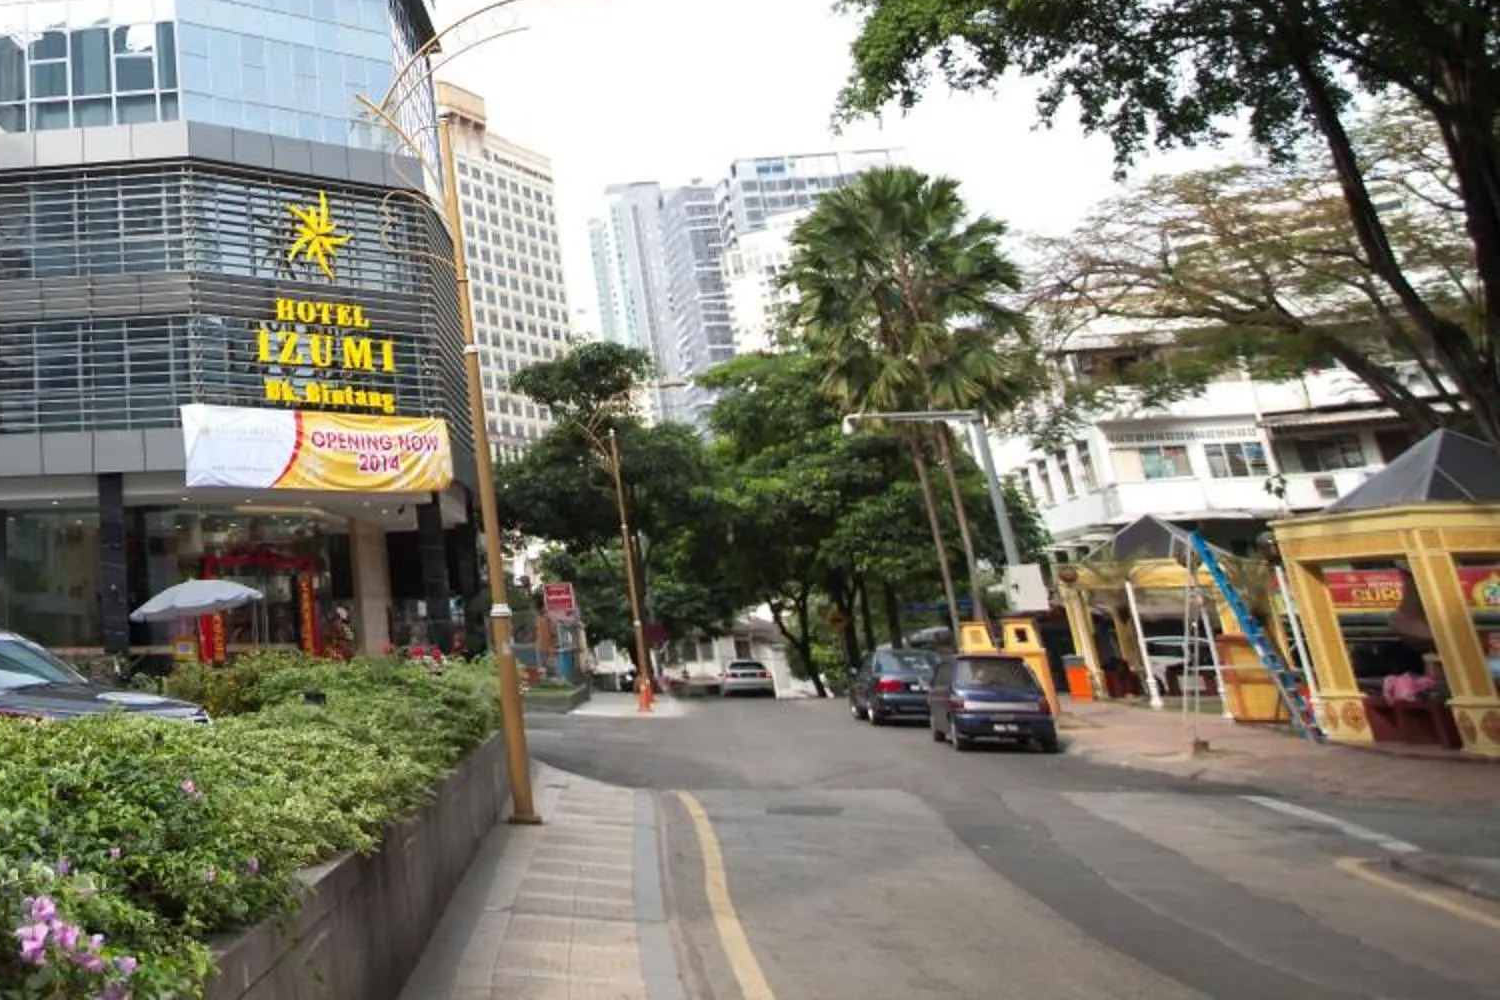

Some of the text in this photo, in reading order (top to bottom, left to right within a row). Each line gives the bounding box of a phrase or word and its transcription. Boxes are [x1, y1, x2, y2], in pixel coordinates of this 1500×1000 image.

[276, 297, 370, 328] HOTEL
[256, 327, 395, 373] IZUMI
[305, 381, 395, 414] Bintang
[311, 430, 439, 452] OPENING NOW
[358, 453, 400, 473] 2014
